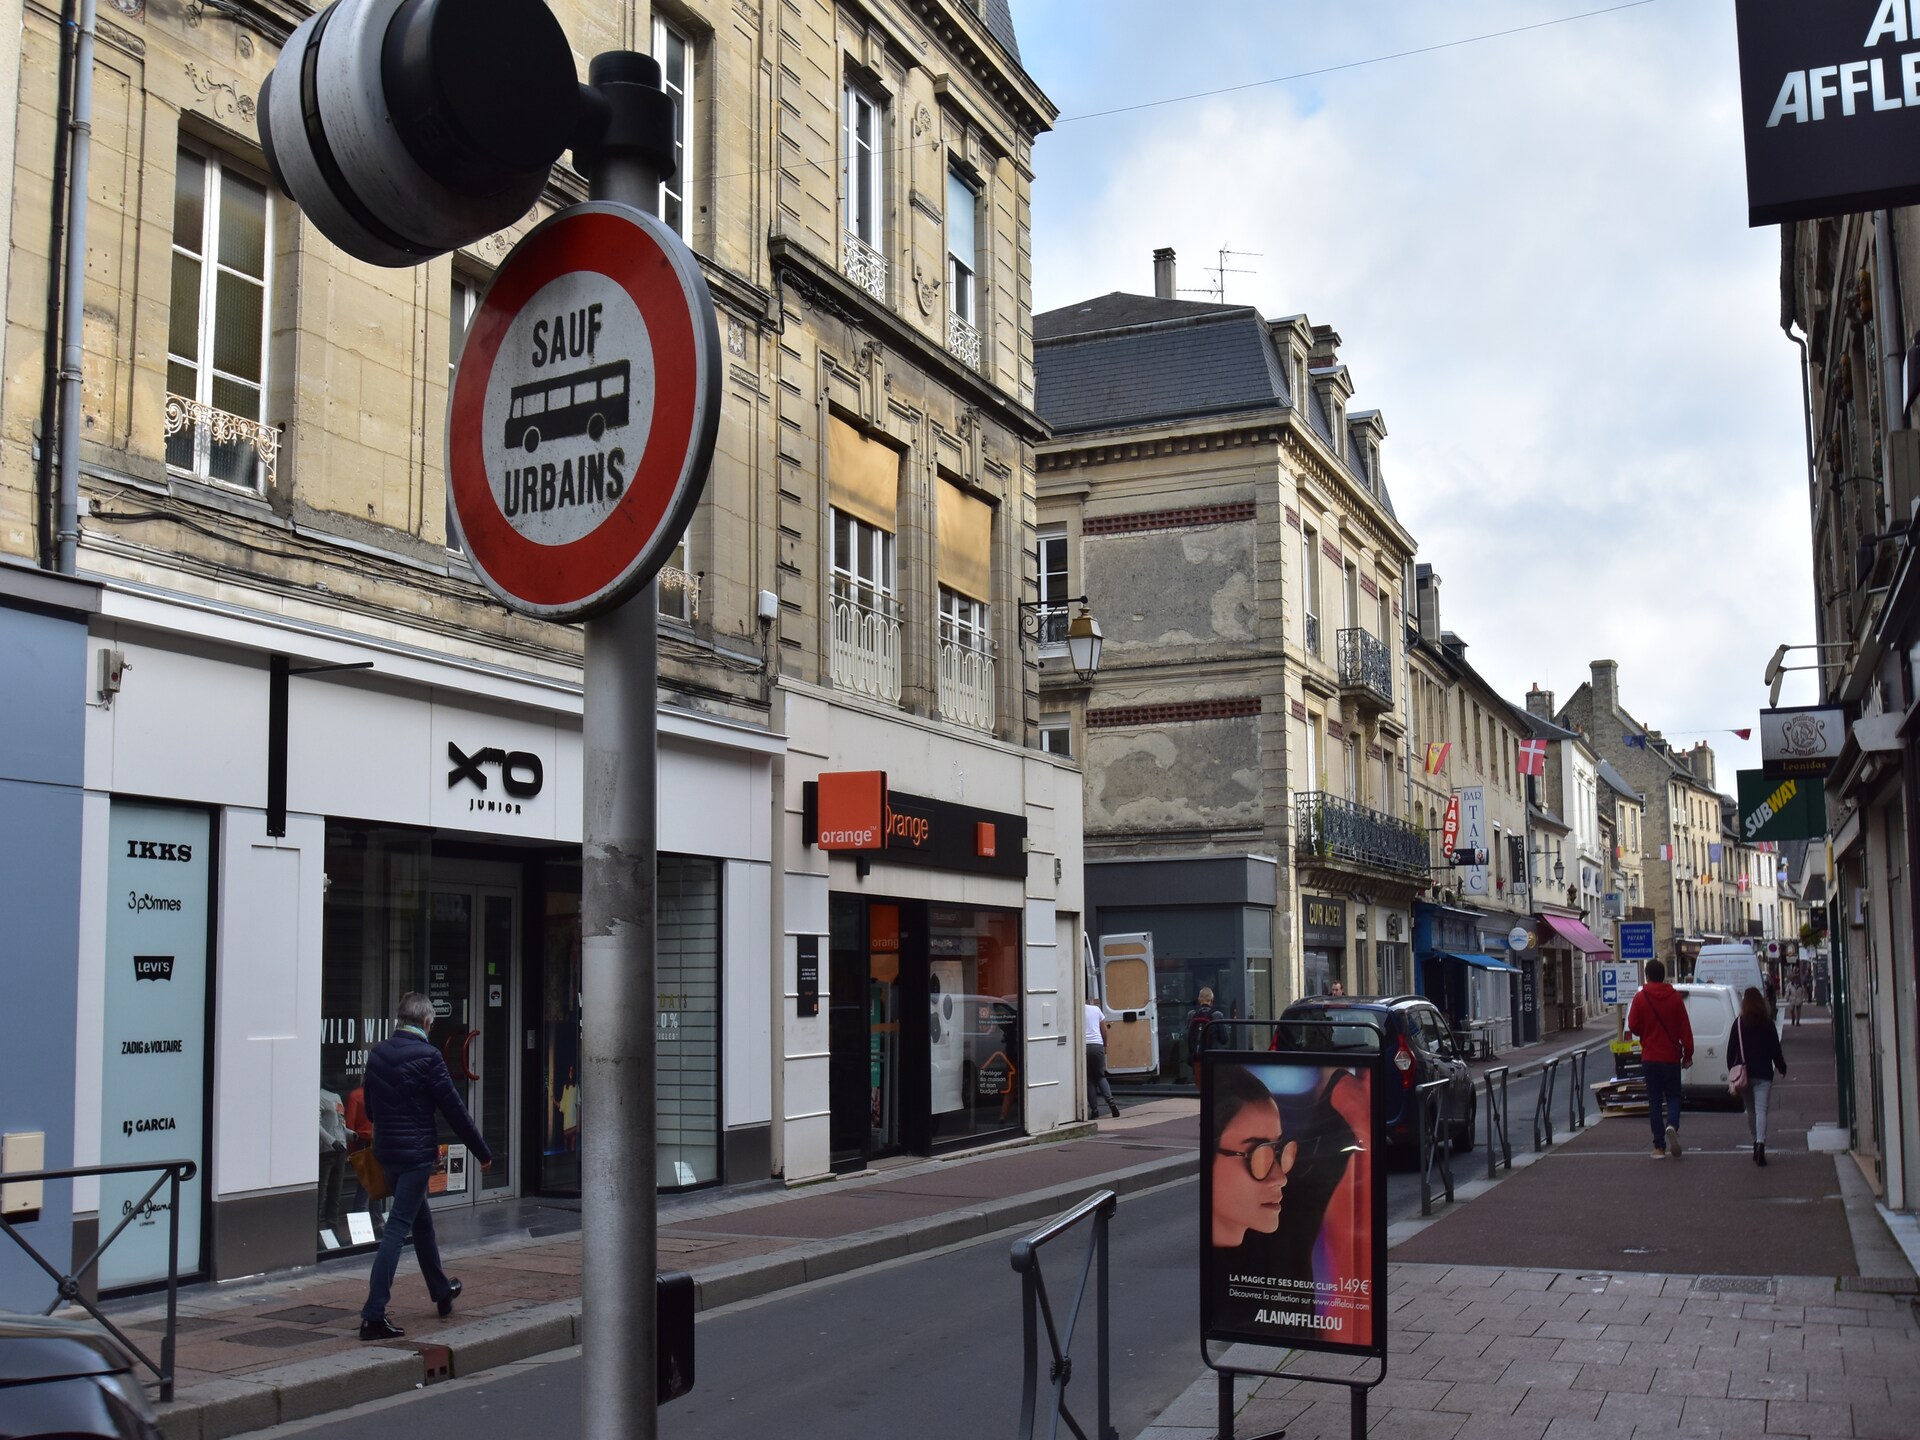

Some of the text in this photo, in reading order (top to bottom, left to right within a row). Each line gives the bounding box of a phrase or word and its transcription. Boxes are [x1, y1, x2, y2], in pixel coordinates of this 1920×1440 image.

[532, 303, 603, 368] SAUF
[504, 448, 626, 518] URBAINS
[1783, 761, 1827, 771] Leonidas
[1464, 792, 1482, 800] BAR
[470, 799, 521, 815] JUNIOR
[1745, 779, 1798, 838] SUBWAY
[1444, 797, 1458, 855] TABAC
[821, 829, 872, 846] orange
[127, 840, 192, 863] IKKS
[345, 1050, 369, 1066] JUSQ
[136, 1117, 176, 1132] GARCIA
[1229, 1274, 1239, 1282] LA
[1241, 1275, 1266, 1284] MAGIC
[1278, 1279, 1292, 1287] SES
[1293, 1280, 1314, 1289] DEUX
[1315, 1282, 1338, 1291] CLIPS
[1229, 1288, 1262, 1299] Découvrez
[1263, 1291, 1270, 1300] la
[1271, 1291, 1299, 1303] collection
[1313, 1298, 1370, 1311] www.afflelou.com
